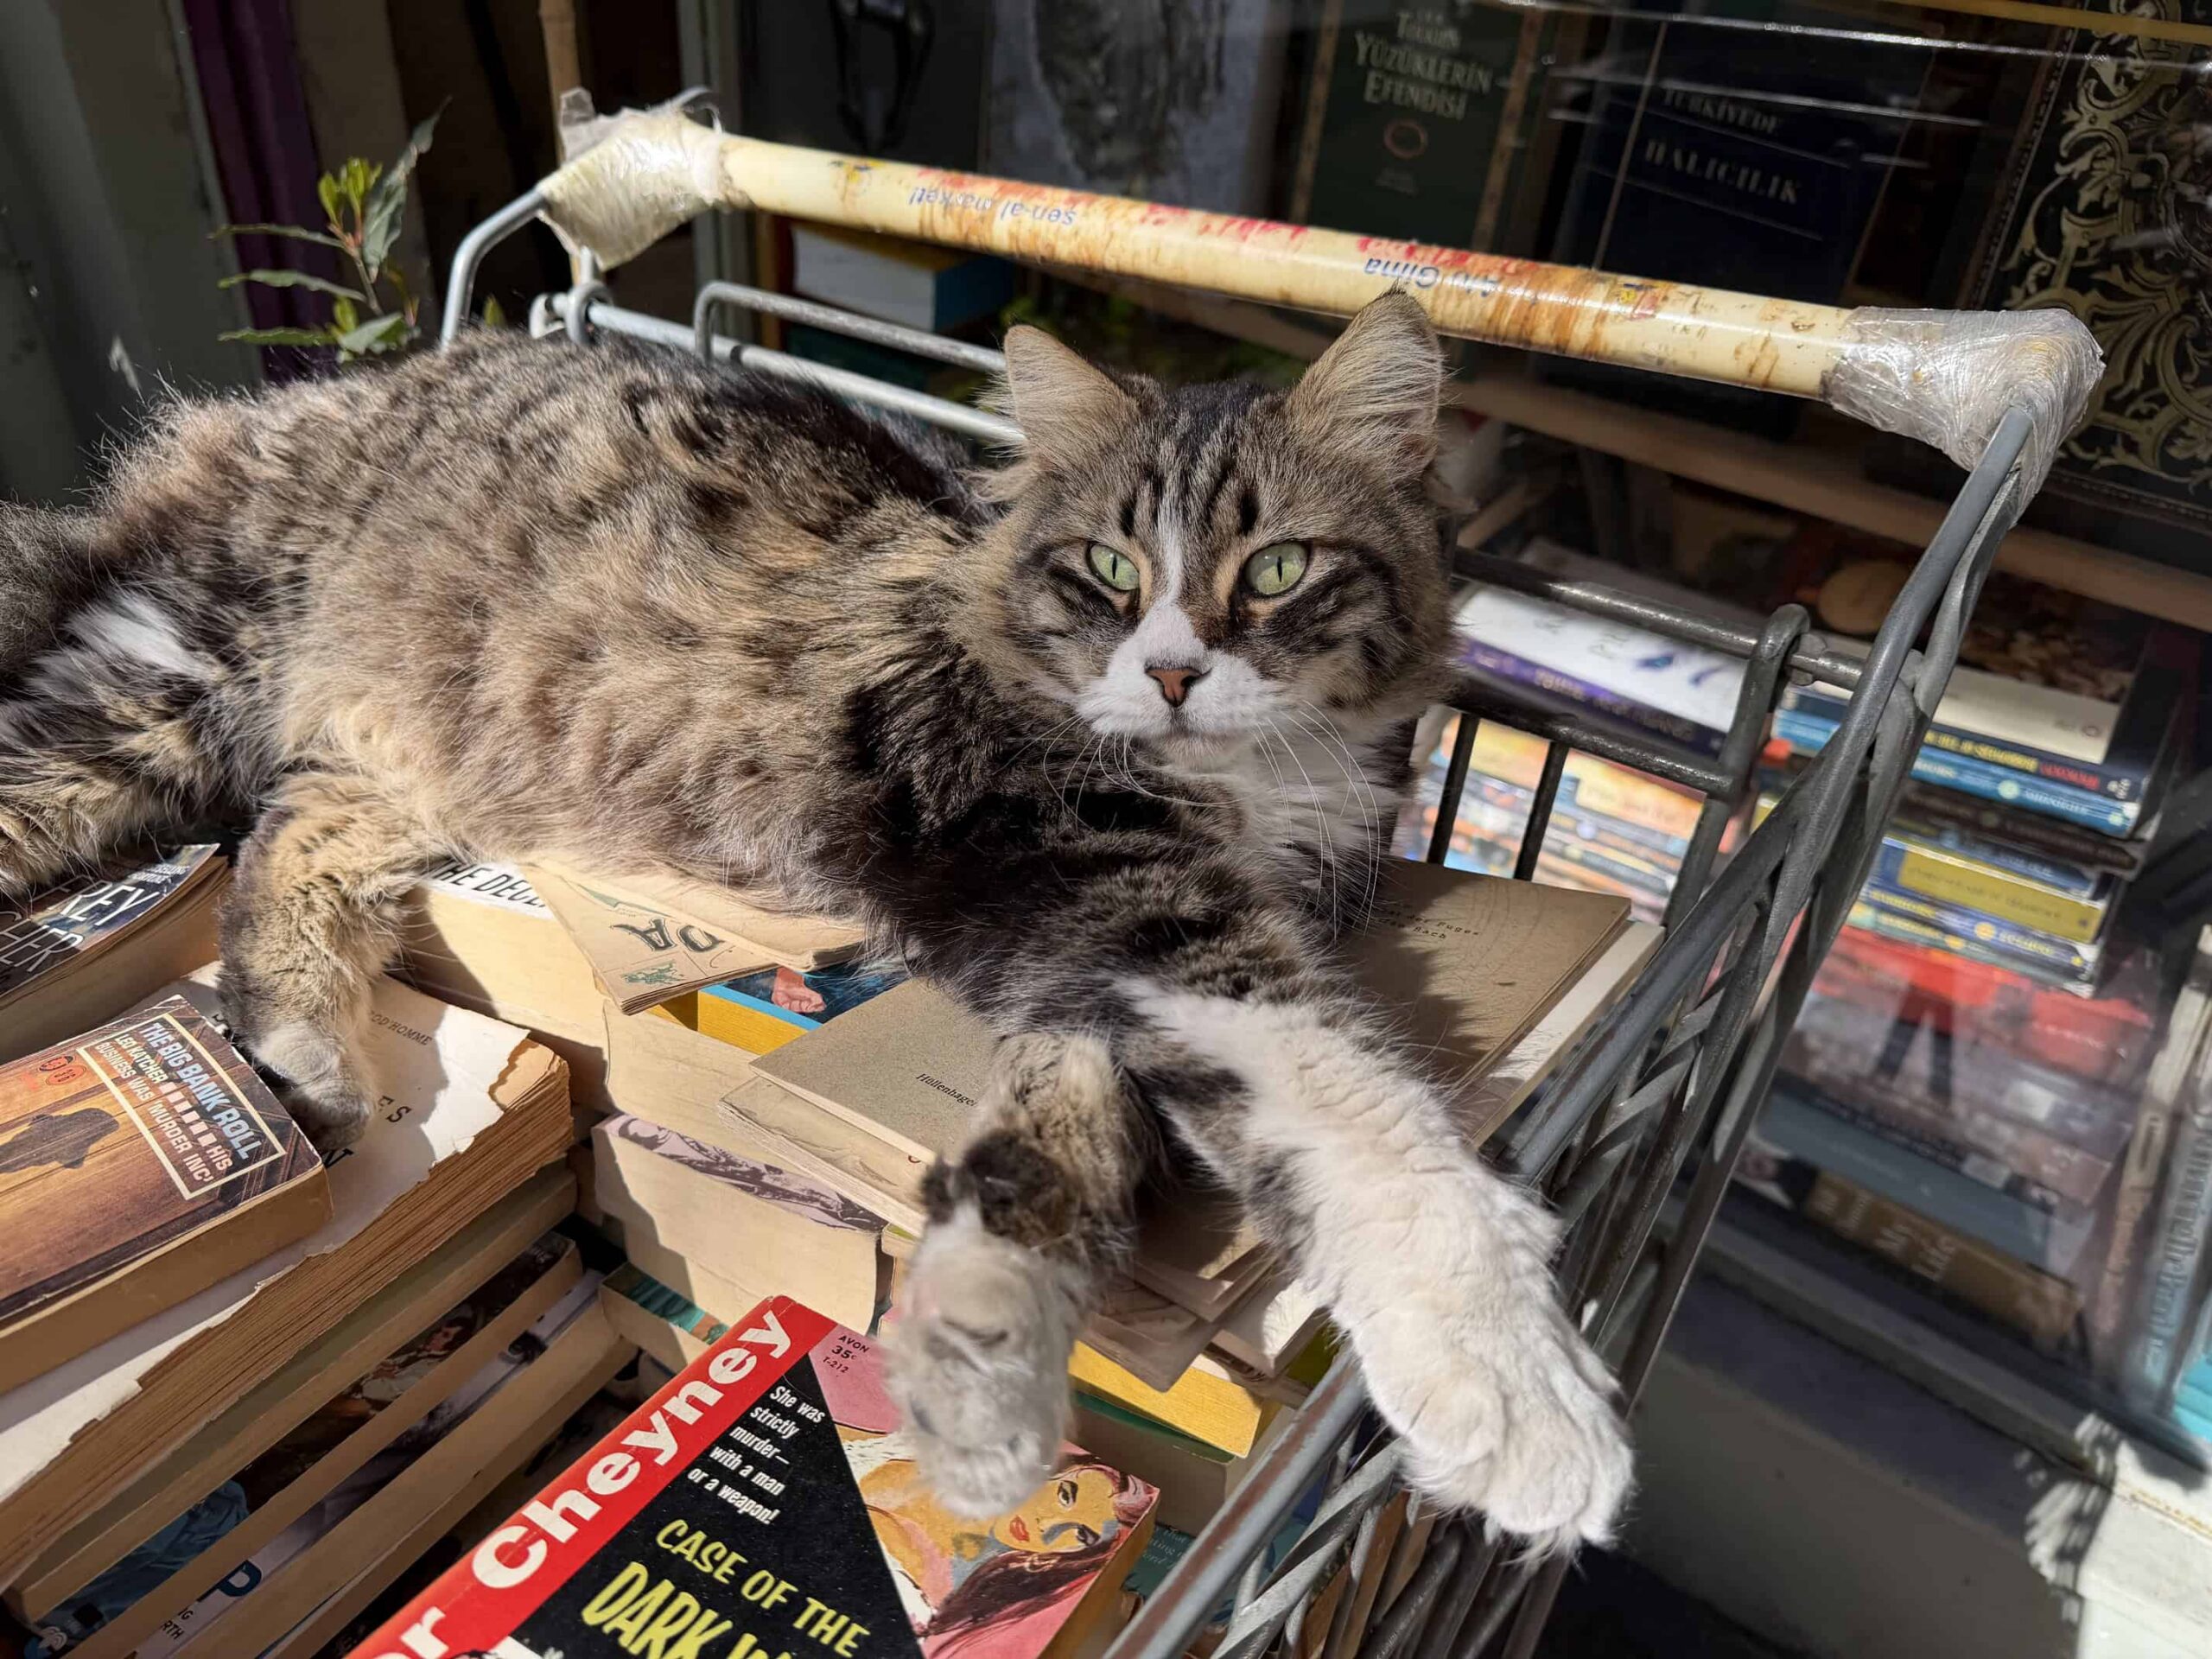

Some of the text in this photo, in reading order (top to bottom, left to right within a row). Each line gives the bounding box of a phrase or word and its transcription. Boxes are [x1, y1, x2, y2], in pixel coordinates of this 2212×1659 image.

[95, 1042, 137, 1079] BUSINESS
[130, 1077, 156, 1102] WAS
[140, 1022, 263, 1160] THE BIG BANK ROLL
[116, 1033, 233, 1171] LEO KATCHER HIS
[823, 1357, 849, 1374] T-212
[838, 1335, 870, 1353] AVON
[750, 1406, 800, 1440] strictly
[769, 1385, 826, 1424] She was
[471, 1310, 793, 1592] Cheyney
[709, 1446, 786, 1497] with a man
[687, 1468, 781, 1525] or a weapon!
[581, 1560, 734, 1659] DARK
[655, 1518, 748, 1585] CASE
[741, 1569, 799, 1610] OF
[792, 1597, 871, 1658] THE
